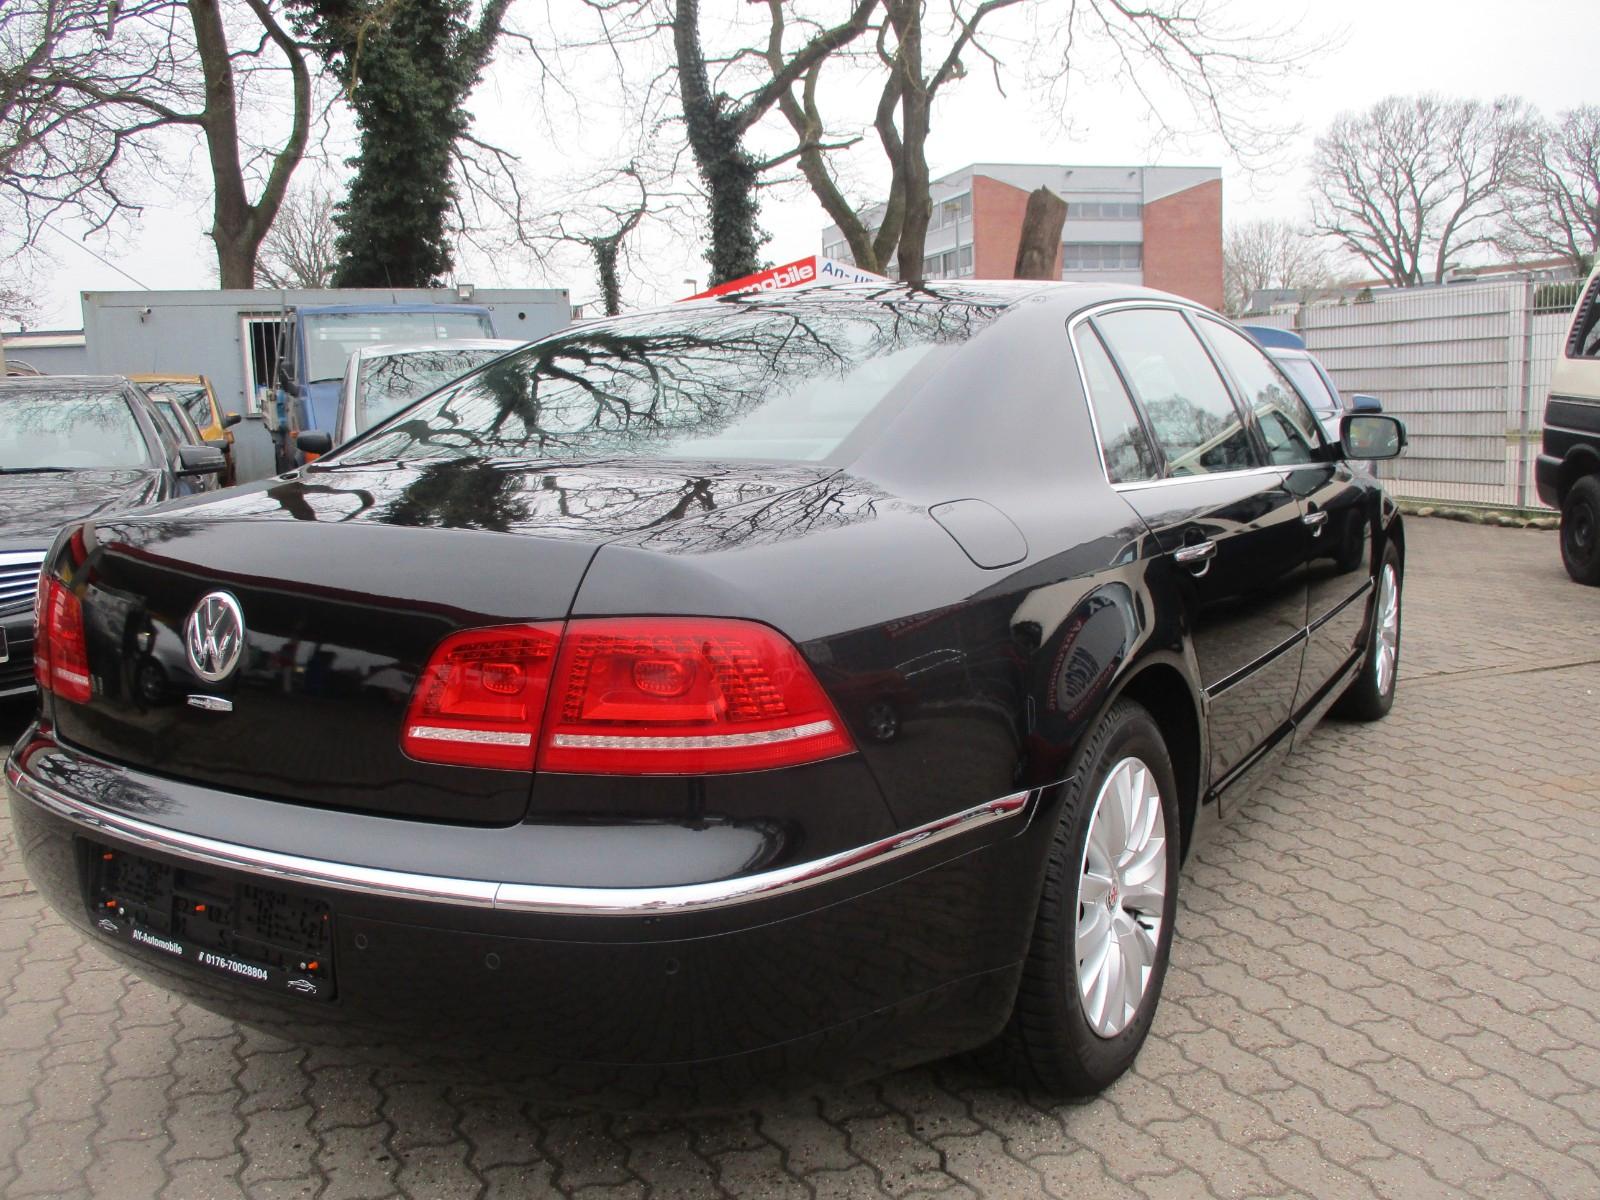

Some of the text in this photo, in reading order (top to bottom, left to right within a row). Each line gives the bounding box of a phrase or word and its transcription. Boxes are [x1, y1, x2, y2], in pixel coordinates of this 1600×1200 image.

[822, 262, 850, 279] An-
[132, 929, 183, 955] AY-Automobile
[206, 953, 268, 981] 0176-70028804
